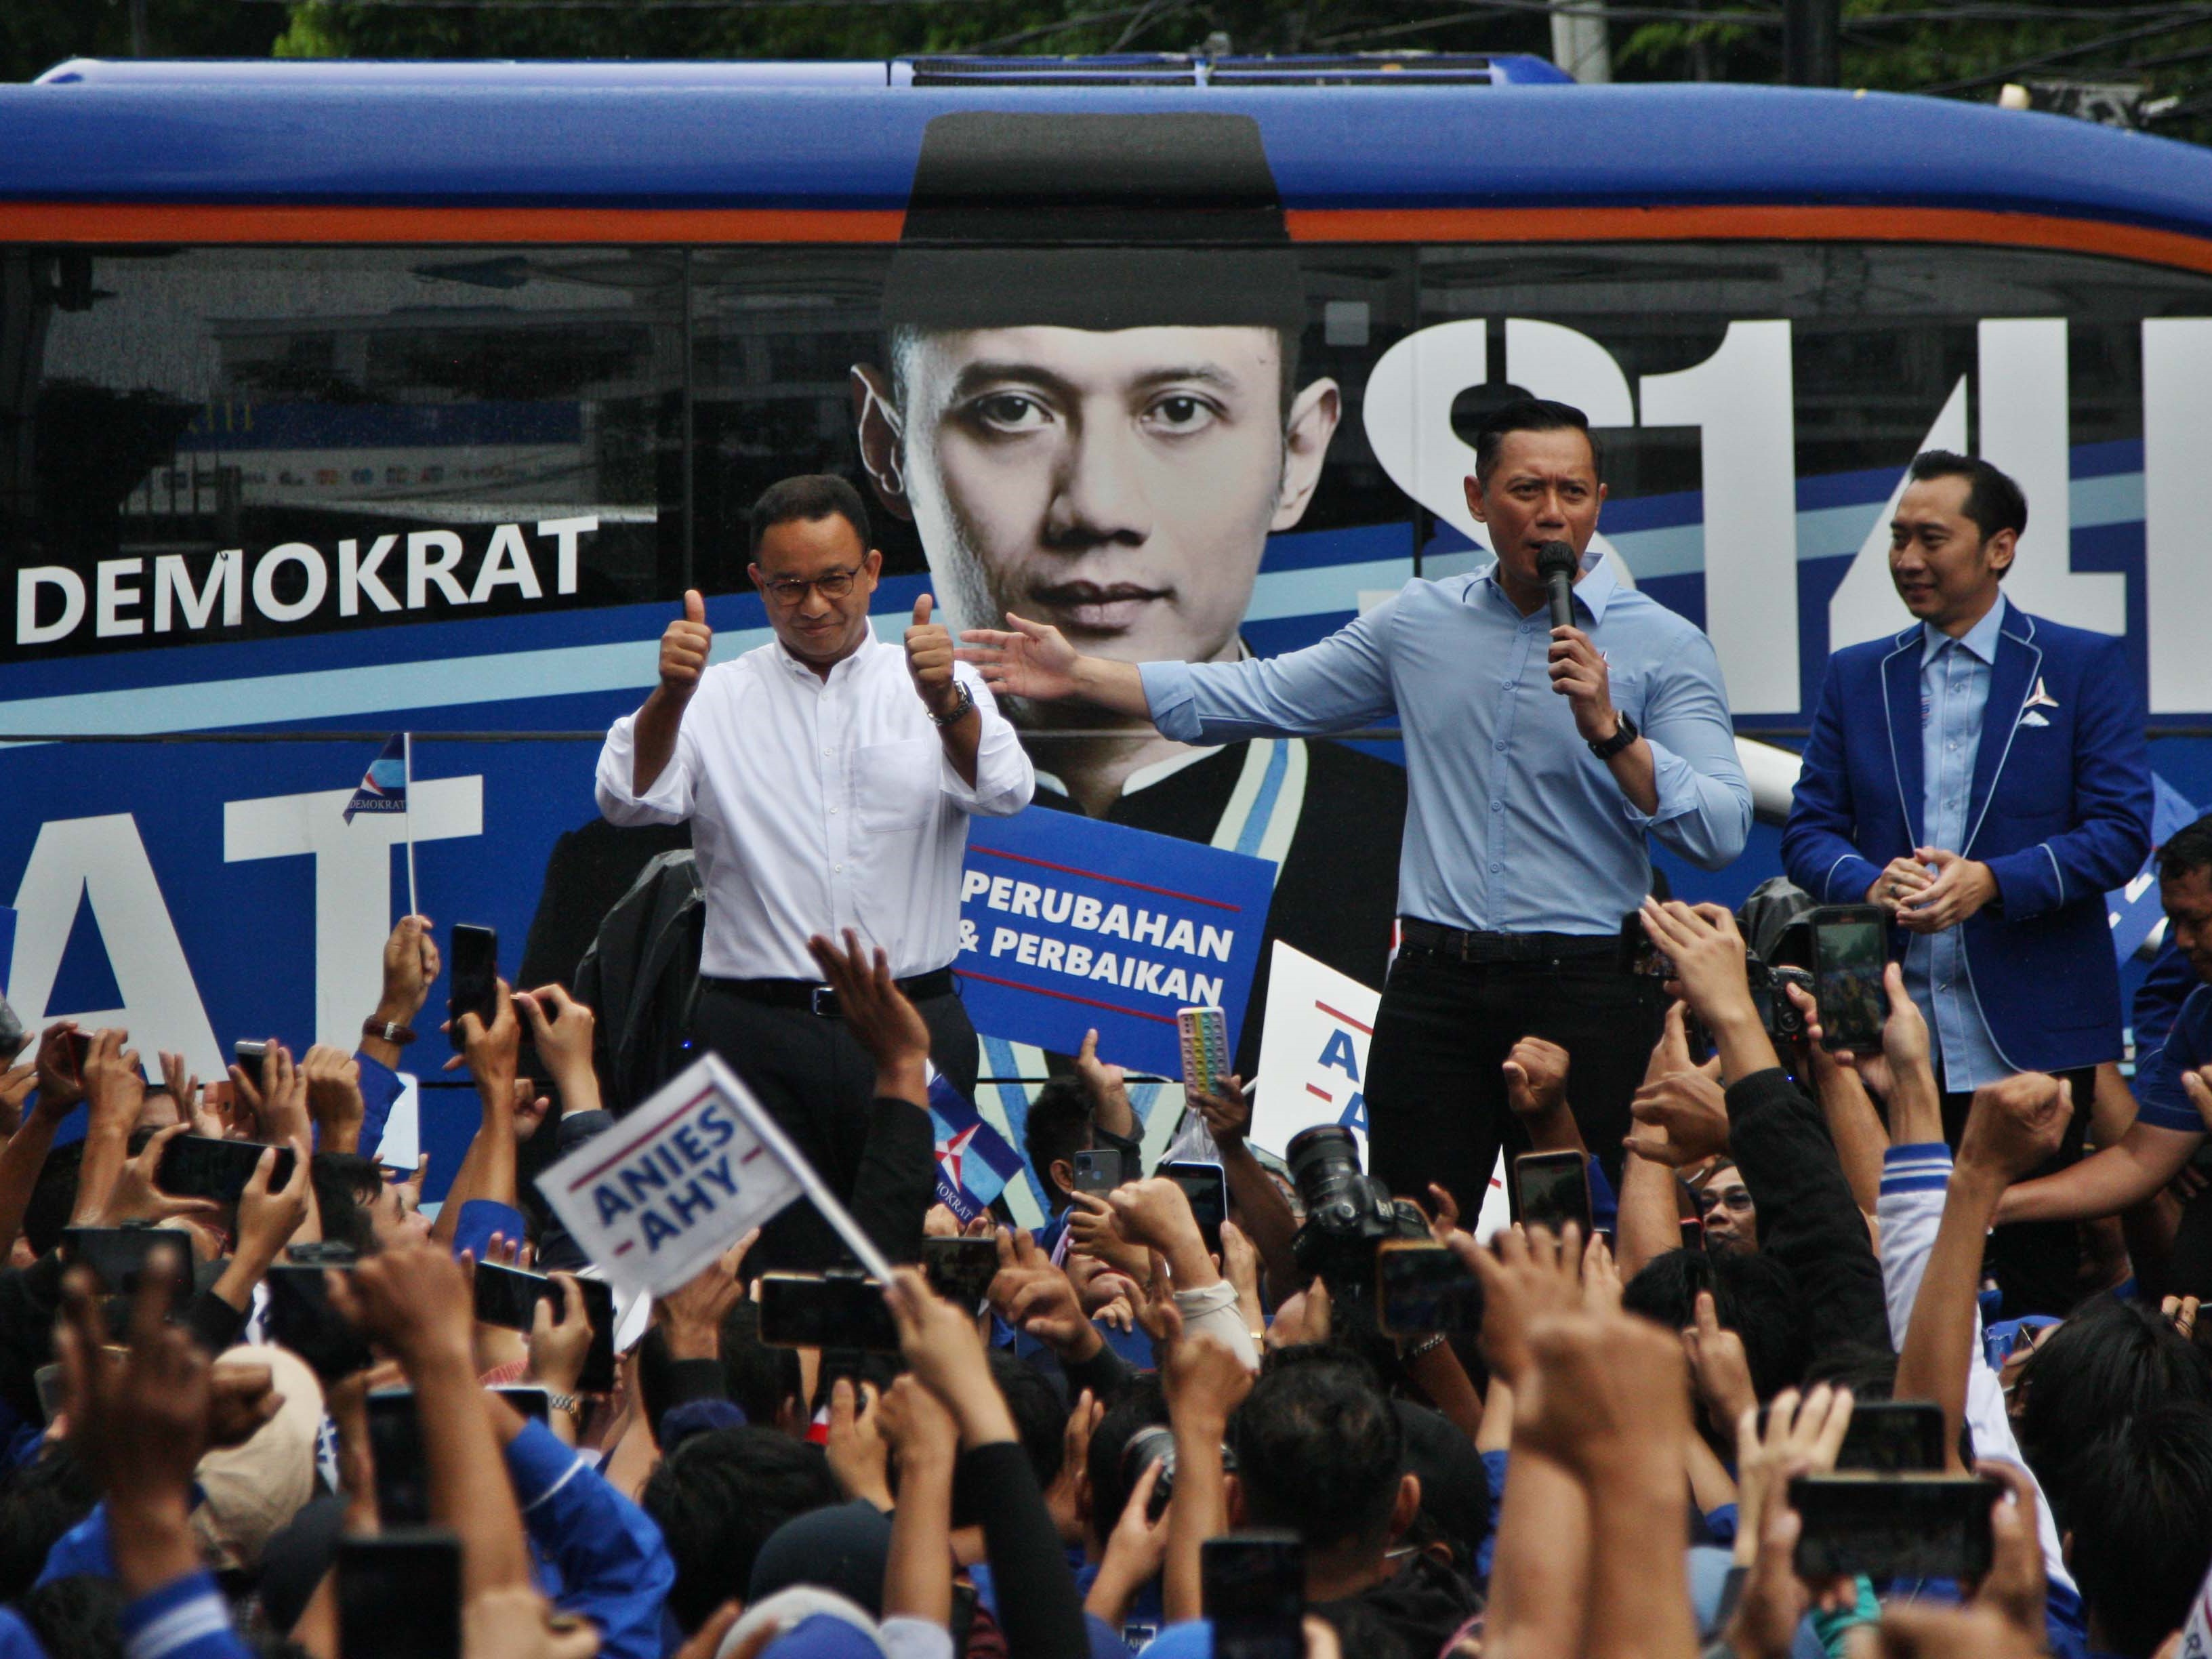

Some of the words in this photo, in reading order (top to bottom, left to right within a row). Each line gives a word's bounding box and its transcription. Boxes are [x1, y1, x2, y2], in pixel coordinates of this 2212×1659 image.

[16, 515, 598, 644] DEMOKRAT
[350, 800, 405, 809] DEMOKRAT
[960, 869, 1235, 962] PERUBAHAN
[960, 919, 980, 953] &
[990, 926, 1224, 1007] PERBAIKAN
[593, 1104, 735, 1228] ANIES
[640, 1153, 738, 1252] AHY
